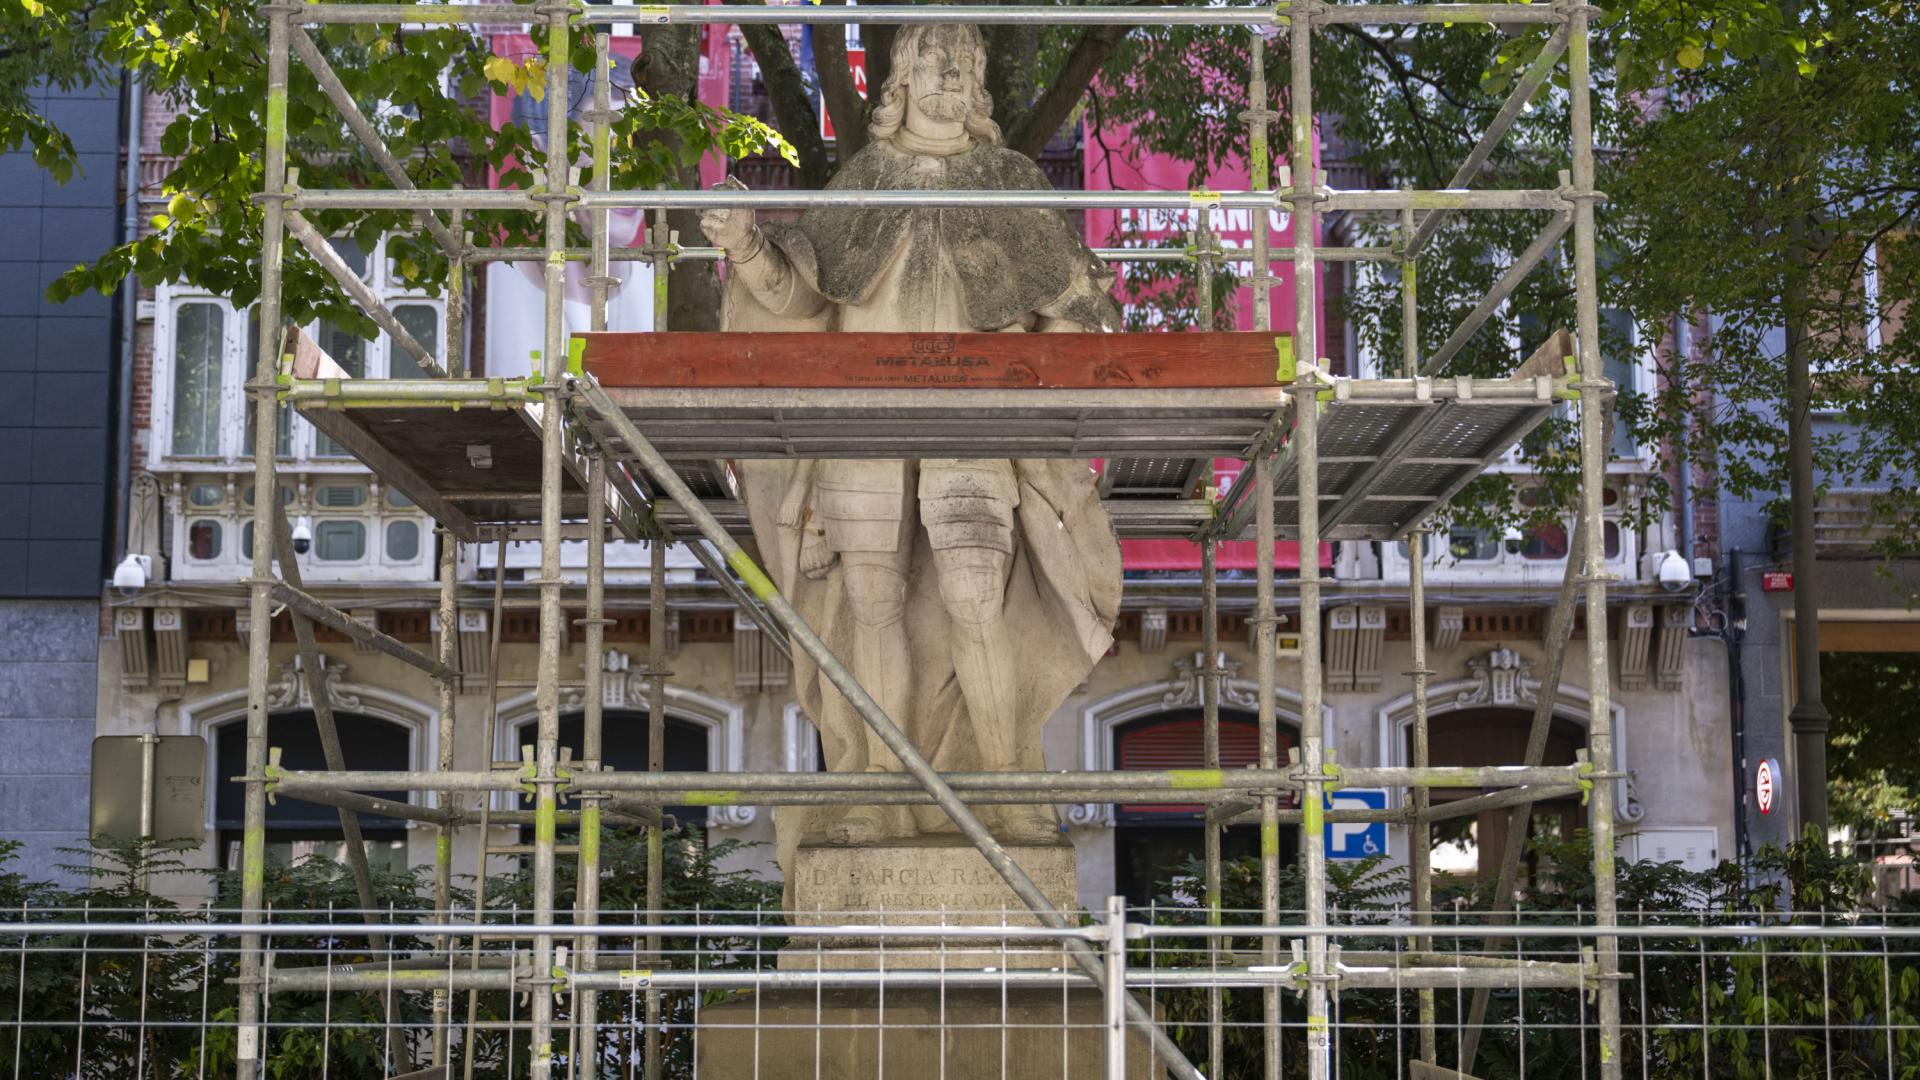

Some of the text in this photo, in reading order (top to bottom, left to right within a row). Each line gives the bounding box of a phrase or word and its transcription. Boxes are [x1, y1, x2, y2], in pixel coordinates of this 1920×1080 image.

[874, 356, 992, 367] METALUSA
[904, 374, 967, 384] METALUSA
[1332, 798, 1372, 852] P
